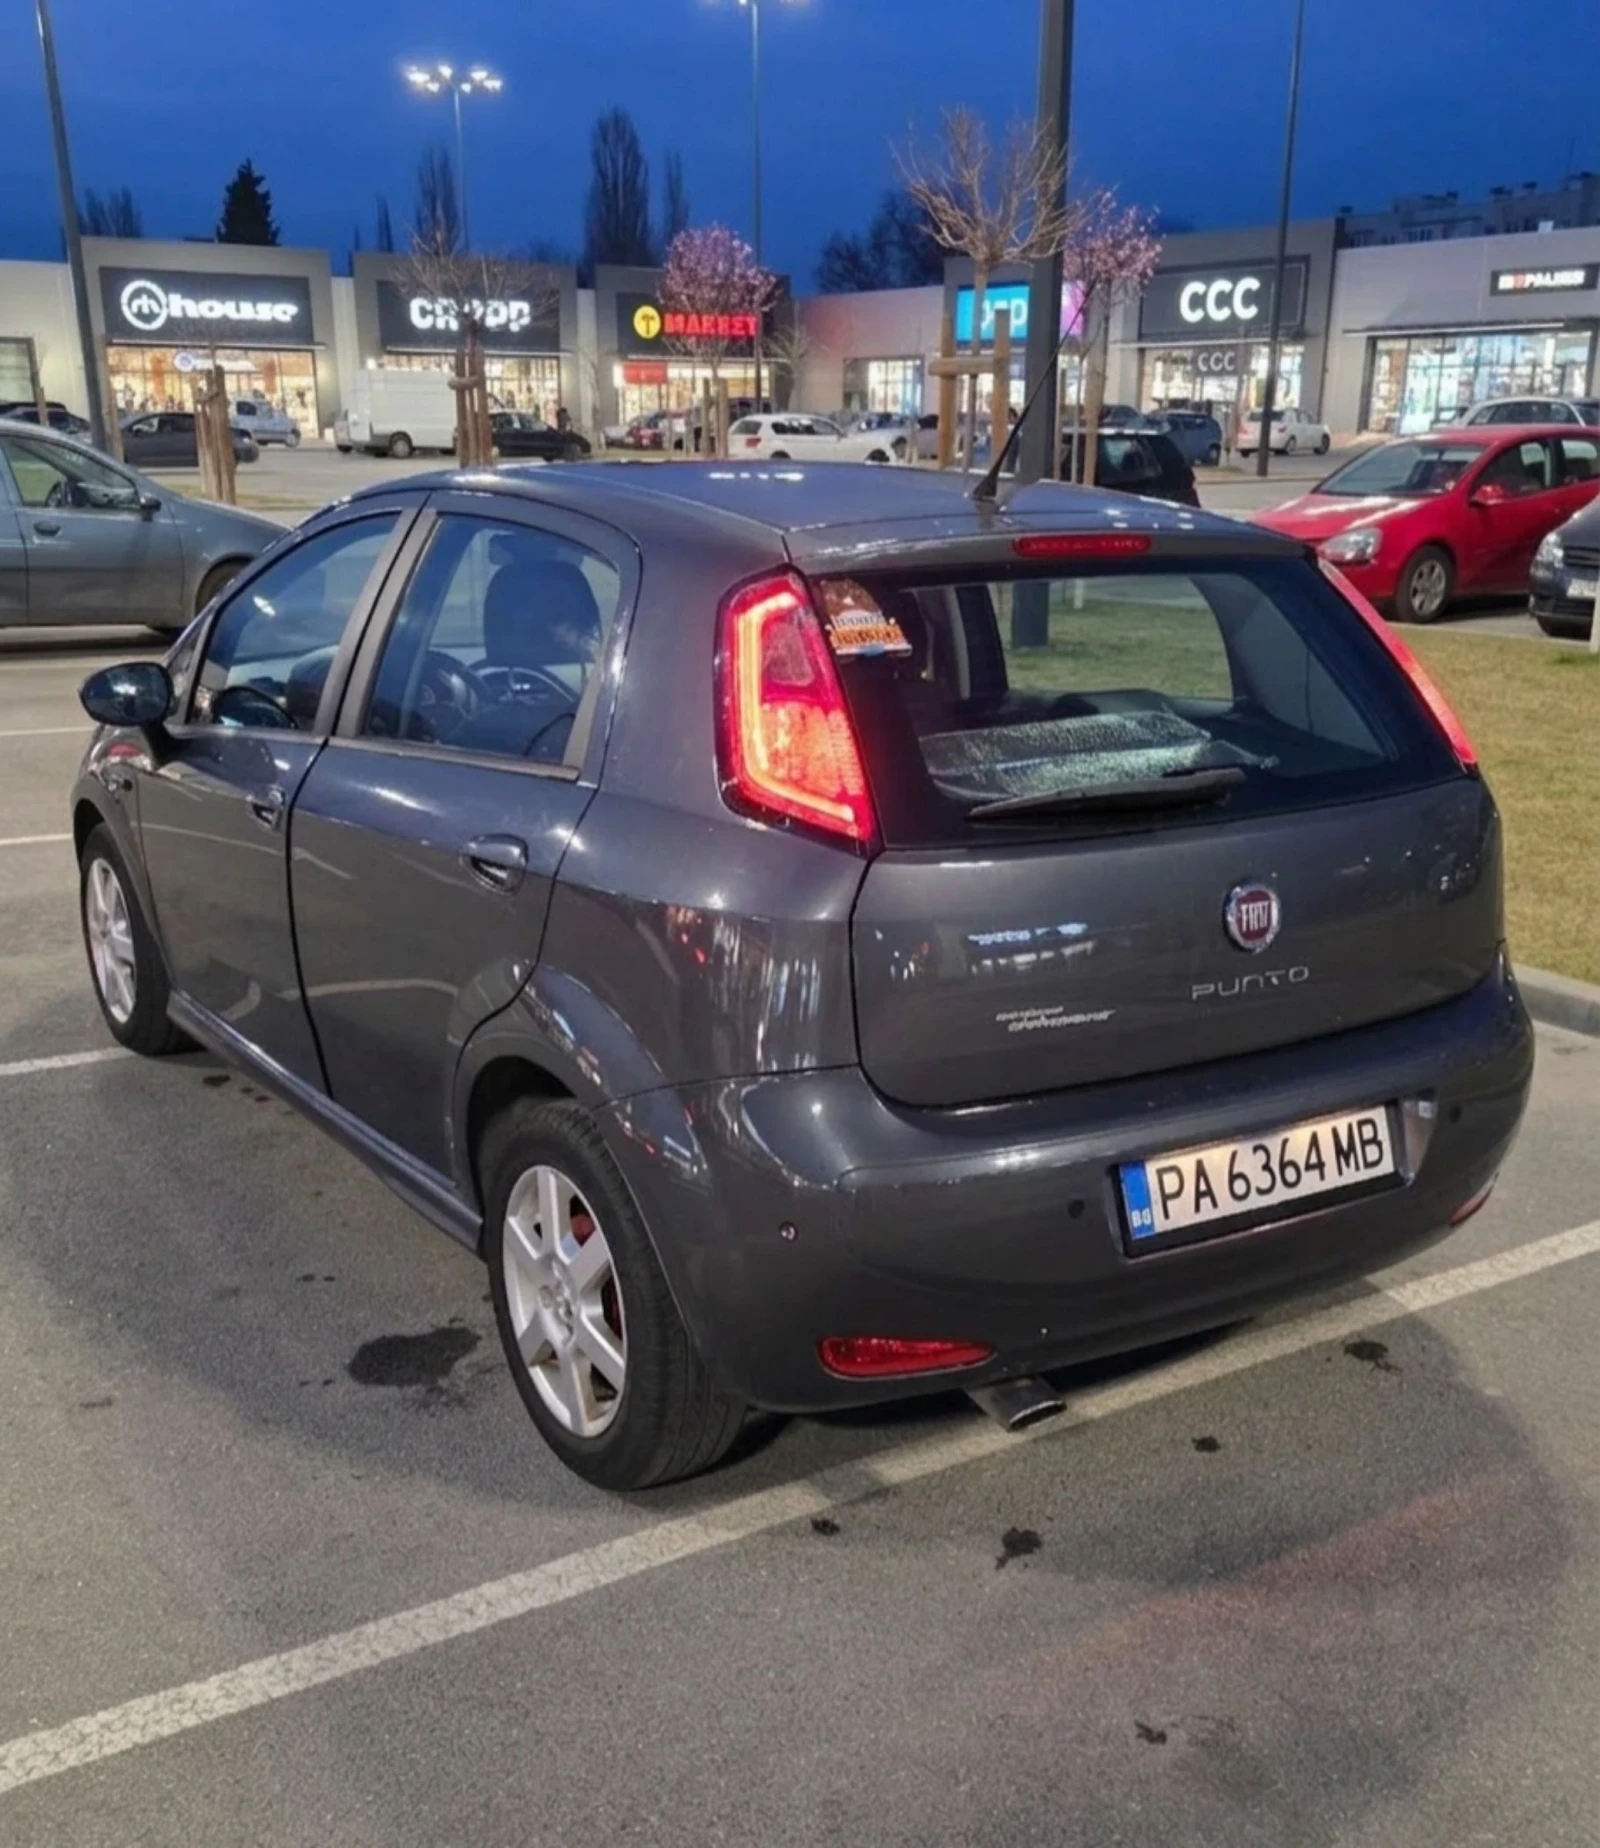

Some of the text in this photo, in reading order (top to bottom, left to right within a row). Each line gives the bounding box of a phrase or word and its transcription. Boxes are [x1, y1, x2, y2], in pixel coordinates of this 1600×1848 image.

[169, 292, 299, 323] house
[1179, 276, 1261, 323] CCC
[664, 312, 758, 336] MARKET
[1197, 351, 1236, 373] CCC
[1240, 899, 1271, 933] FIAT
[1191, 965, 1309, 1001] PUNTO
[1155, 1116, 1384, 1220] PA 6364 MB
[1131, 1208, 1153, 1228] BG
